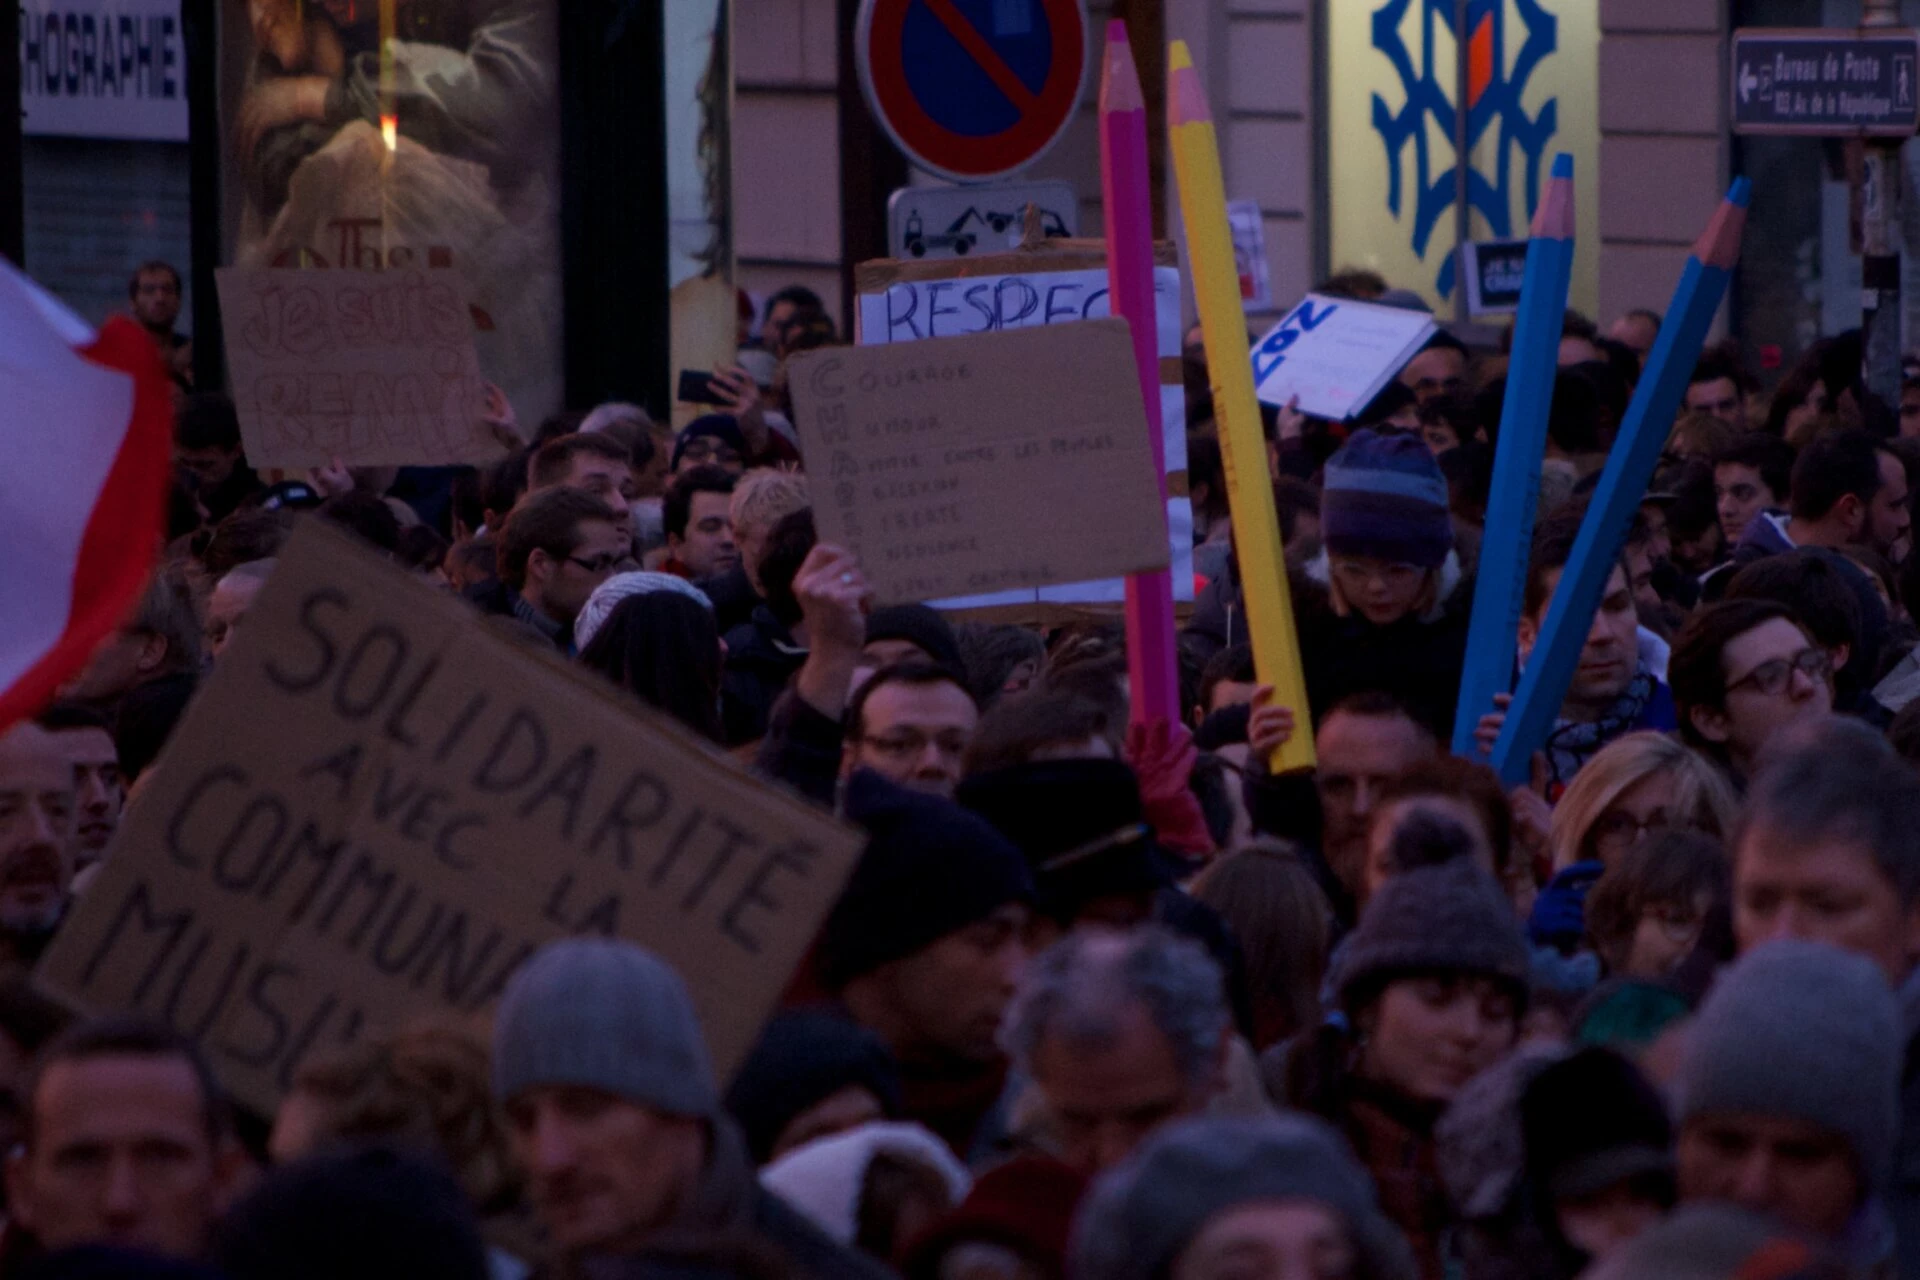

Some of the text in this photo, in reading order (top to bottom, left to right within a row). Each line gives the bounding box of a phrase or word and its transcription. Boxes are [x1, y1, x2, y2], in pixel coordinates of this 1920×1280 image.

[1776, 51, 1880, 82] Bureau de Poste
[886, 277, 1164, 343] RESPE
[264, 585, 820, 955] SOLIDARITÉ
[299, 744, 621, 938] AVEC LA
